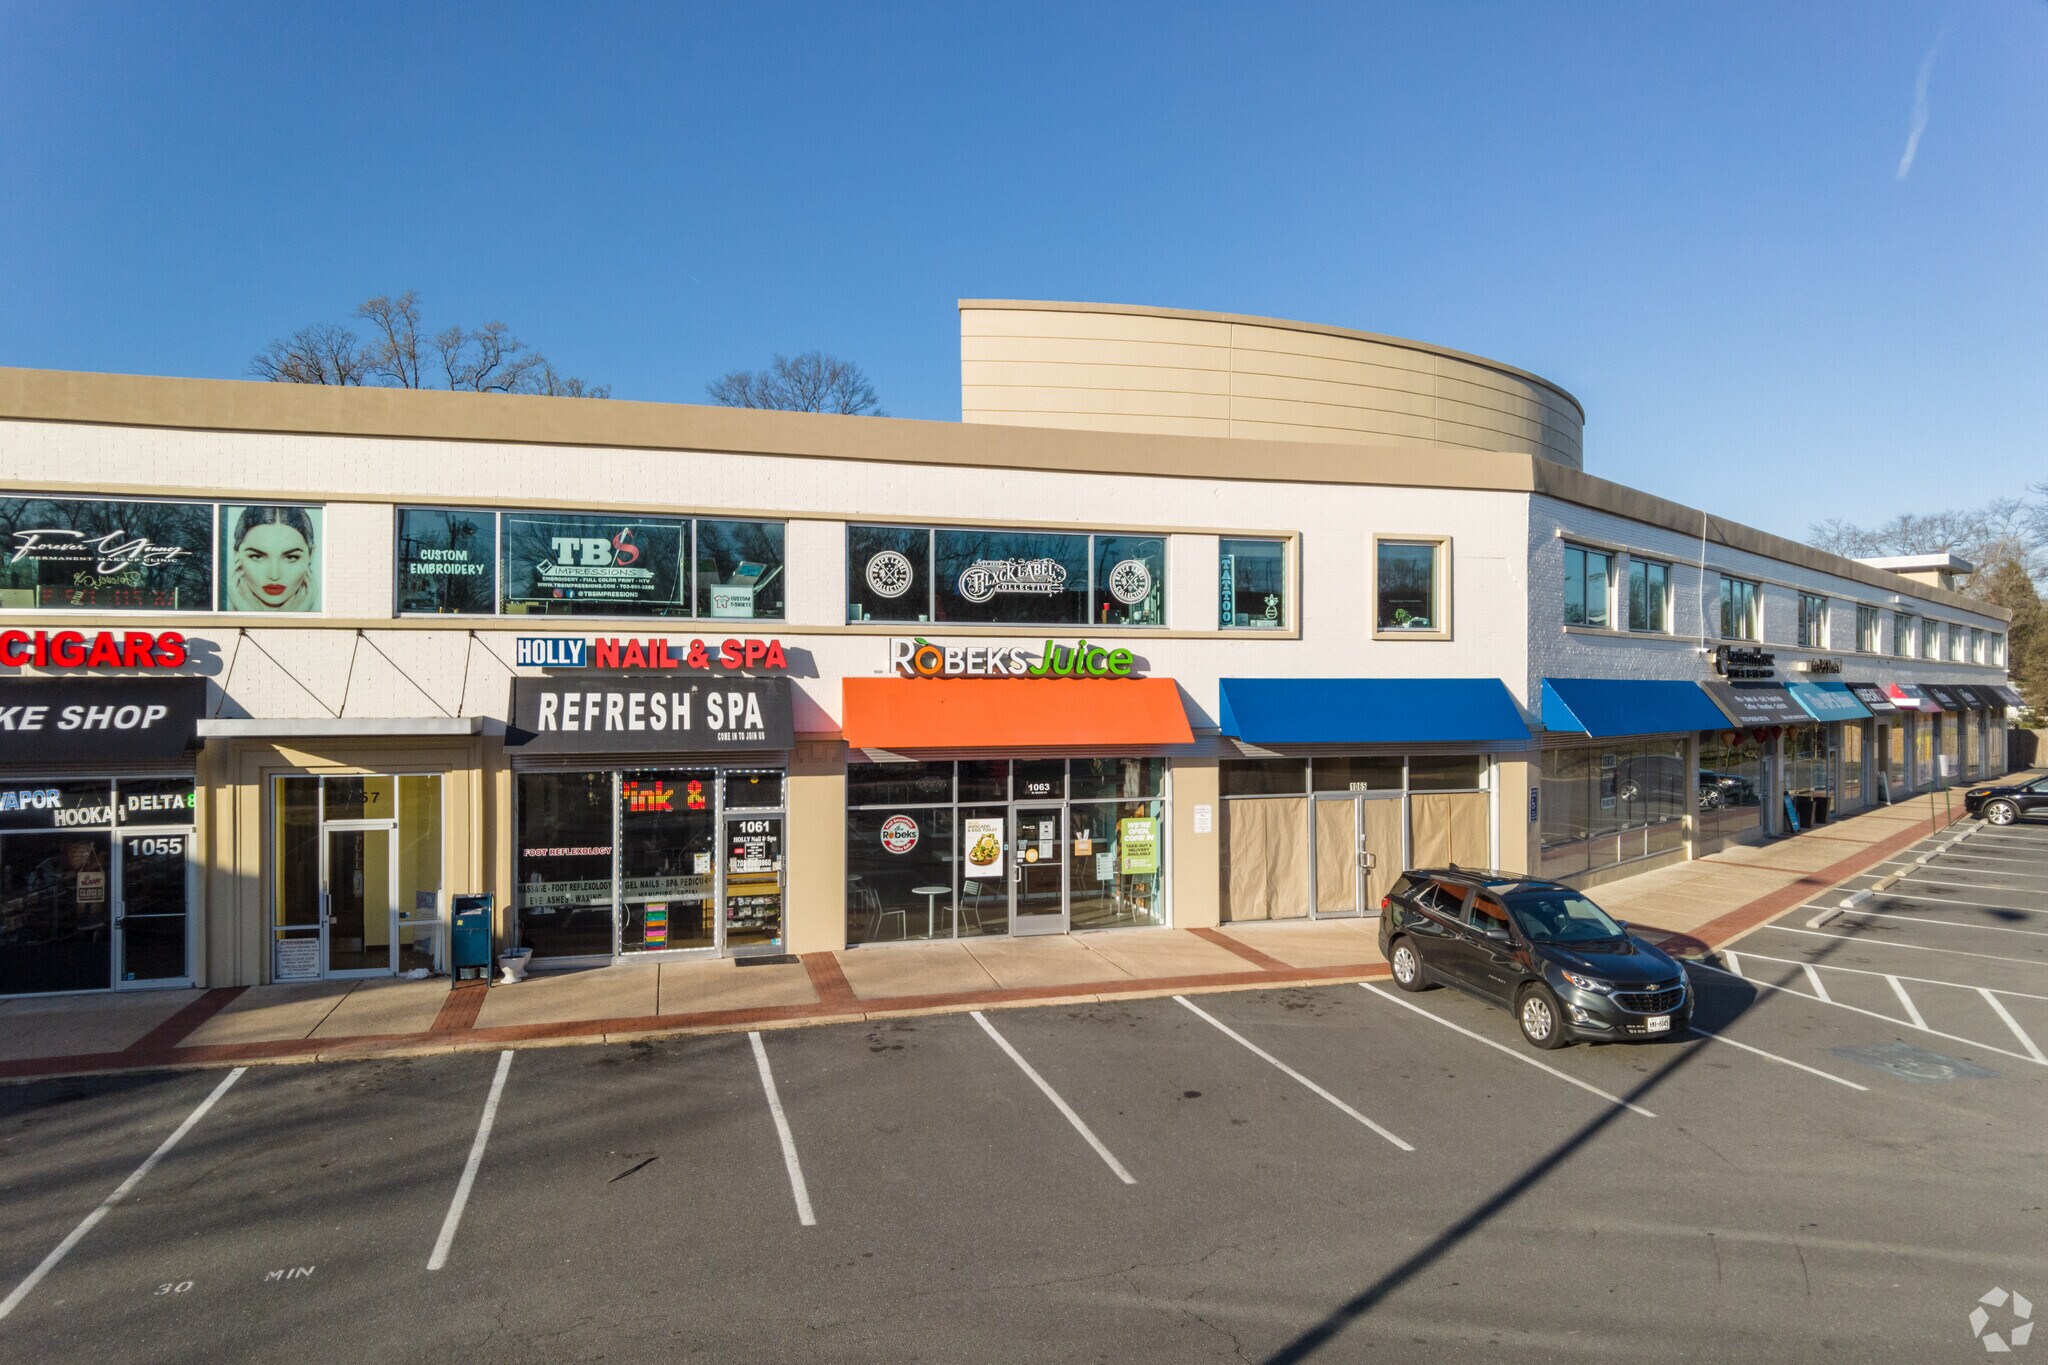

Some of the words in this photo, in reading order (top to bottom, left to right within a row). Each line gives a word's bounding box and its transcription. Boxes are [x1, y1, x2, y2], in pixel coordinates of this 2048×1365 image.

[13, 530, 87, 562] Forever
[82, 530, 192, 574] Young
[420, 549, 468, 561] CUSTOM
[552, 528, 639, 566] TBS
[410, 563, 484, 575] EMBROIDERY
[555, 568, 636, 576] IMPRESSIONS
[1017, 563, 1055, 582] LABEL
[996, 583, 1051, 591] COLLECTIVE
[1220, 559, 1231, 622] TATTOO
[0, 630, 188, 668] CIGARS
[517, 639, 583, 664] HOLLY
[595, 638, 678, 668] NAIL
[687, 638, 709, 669] &
[720, 638, 787, 669] SPA
[889, 638, 1028, 675] ROBEKS
[1028, 639, 1133, 675] Juice
[57, 705, 168, 730] SHOP
[538, 692, 691, 731] REFRESH
[707, 692, 764, 731] SPA
[718, 732, 730, 741] COME
[732, 732, 737, 740] IN
[738, 732, 745, 740] TO
[746, 731, 757, 740] JOIN
[758, 731, 765, 740] US
[623, 781, 674, 811] ink
[687, 780, 705, 809] &
[1028, 783, 1050, 791] 1063
[1350, 782, 1367, 791] 1065
[128, 794, 185, 812] DELTA
[187, 794, 195, 808] 8
[740, 820, 769, 833] 1061
[883, 830, 917, 839] Robeks
[129, 838, 182, 856] 1055
[524, 848, 548, 857] FOOT
[549, 847, 612, 856] REFLEXOLOGY
[552, 884, 567, 892] FOOT
[569, 881, 612, 891] REFLEXOLOGY
[625, 881, 637, 890] GEL
[640, 880, 660, 888] NAILS
[666, 879, 678, 887] SPA
[154, 1281, 195, 1296] 30
[264, 1266, 315, 1281] MIN
